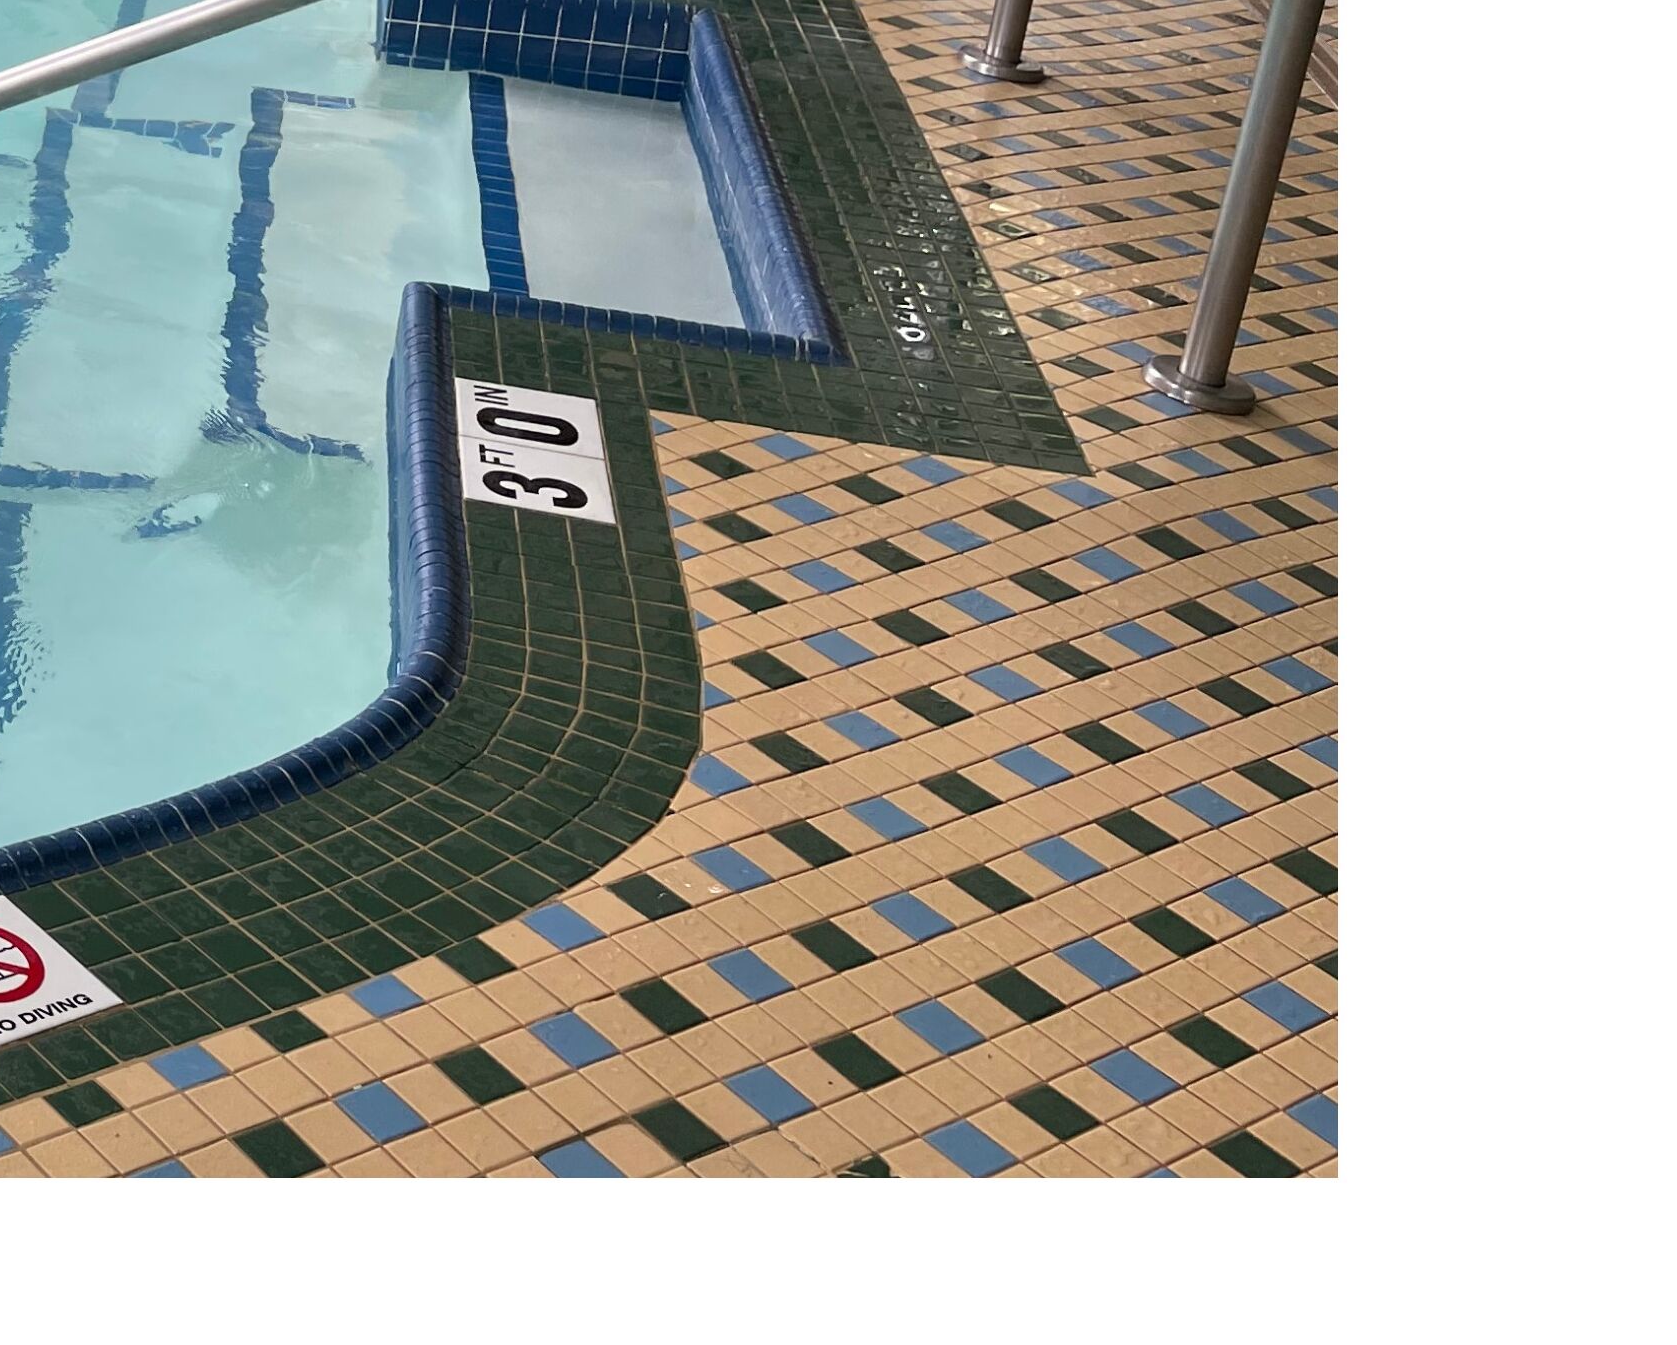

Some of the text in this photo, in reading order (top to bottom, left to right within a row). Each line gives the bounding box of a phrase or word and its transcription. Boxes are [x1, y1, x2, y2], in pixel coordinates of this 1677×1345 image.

[473, 385, 588, 509] 3 FT 0 IN
[18, 993, 93, 1025] DIVING
